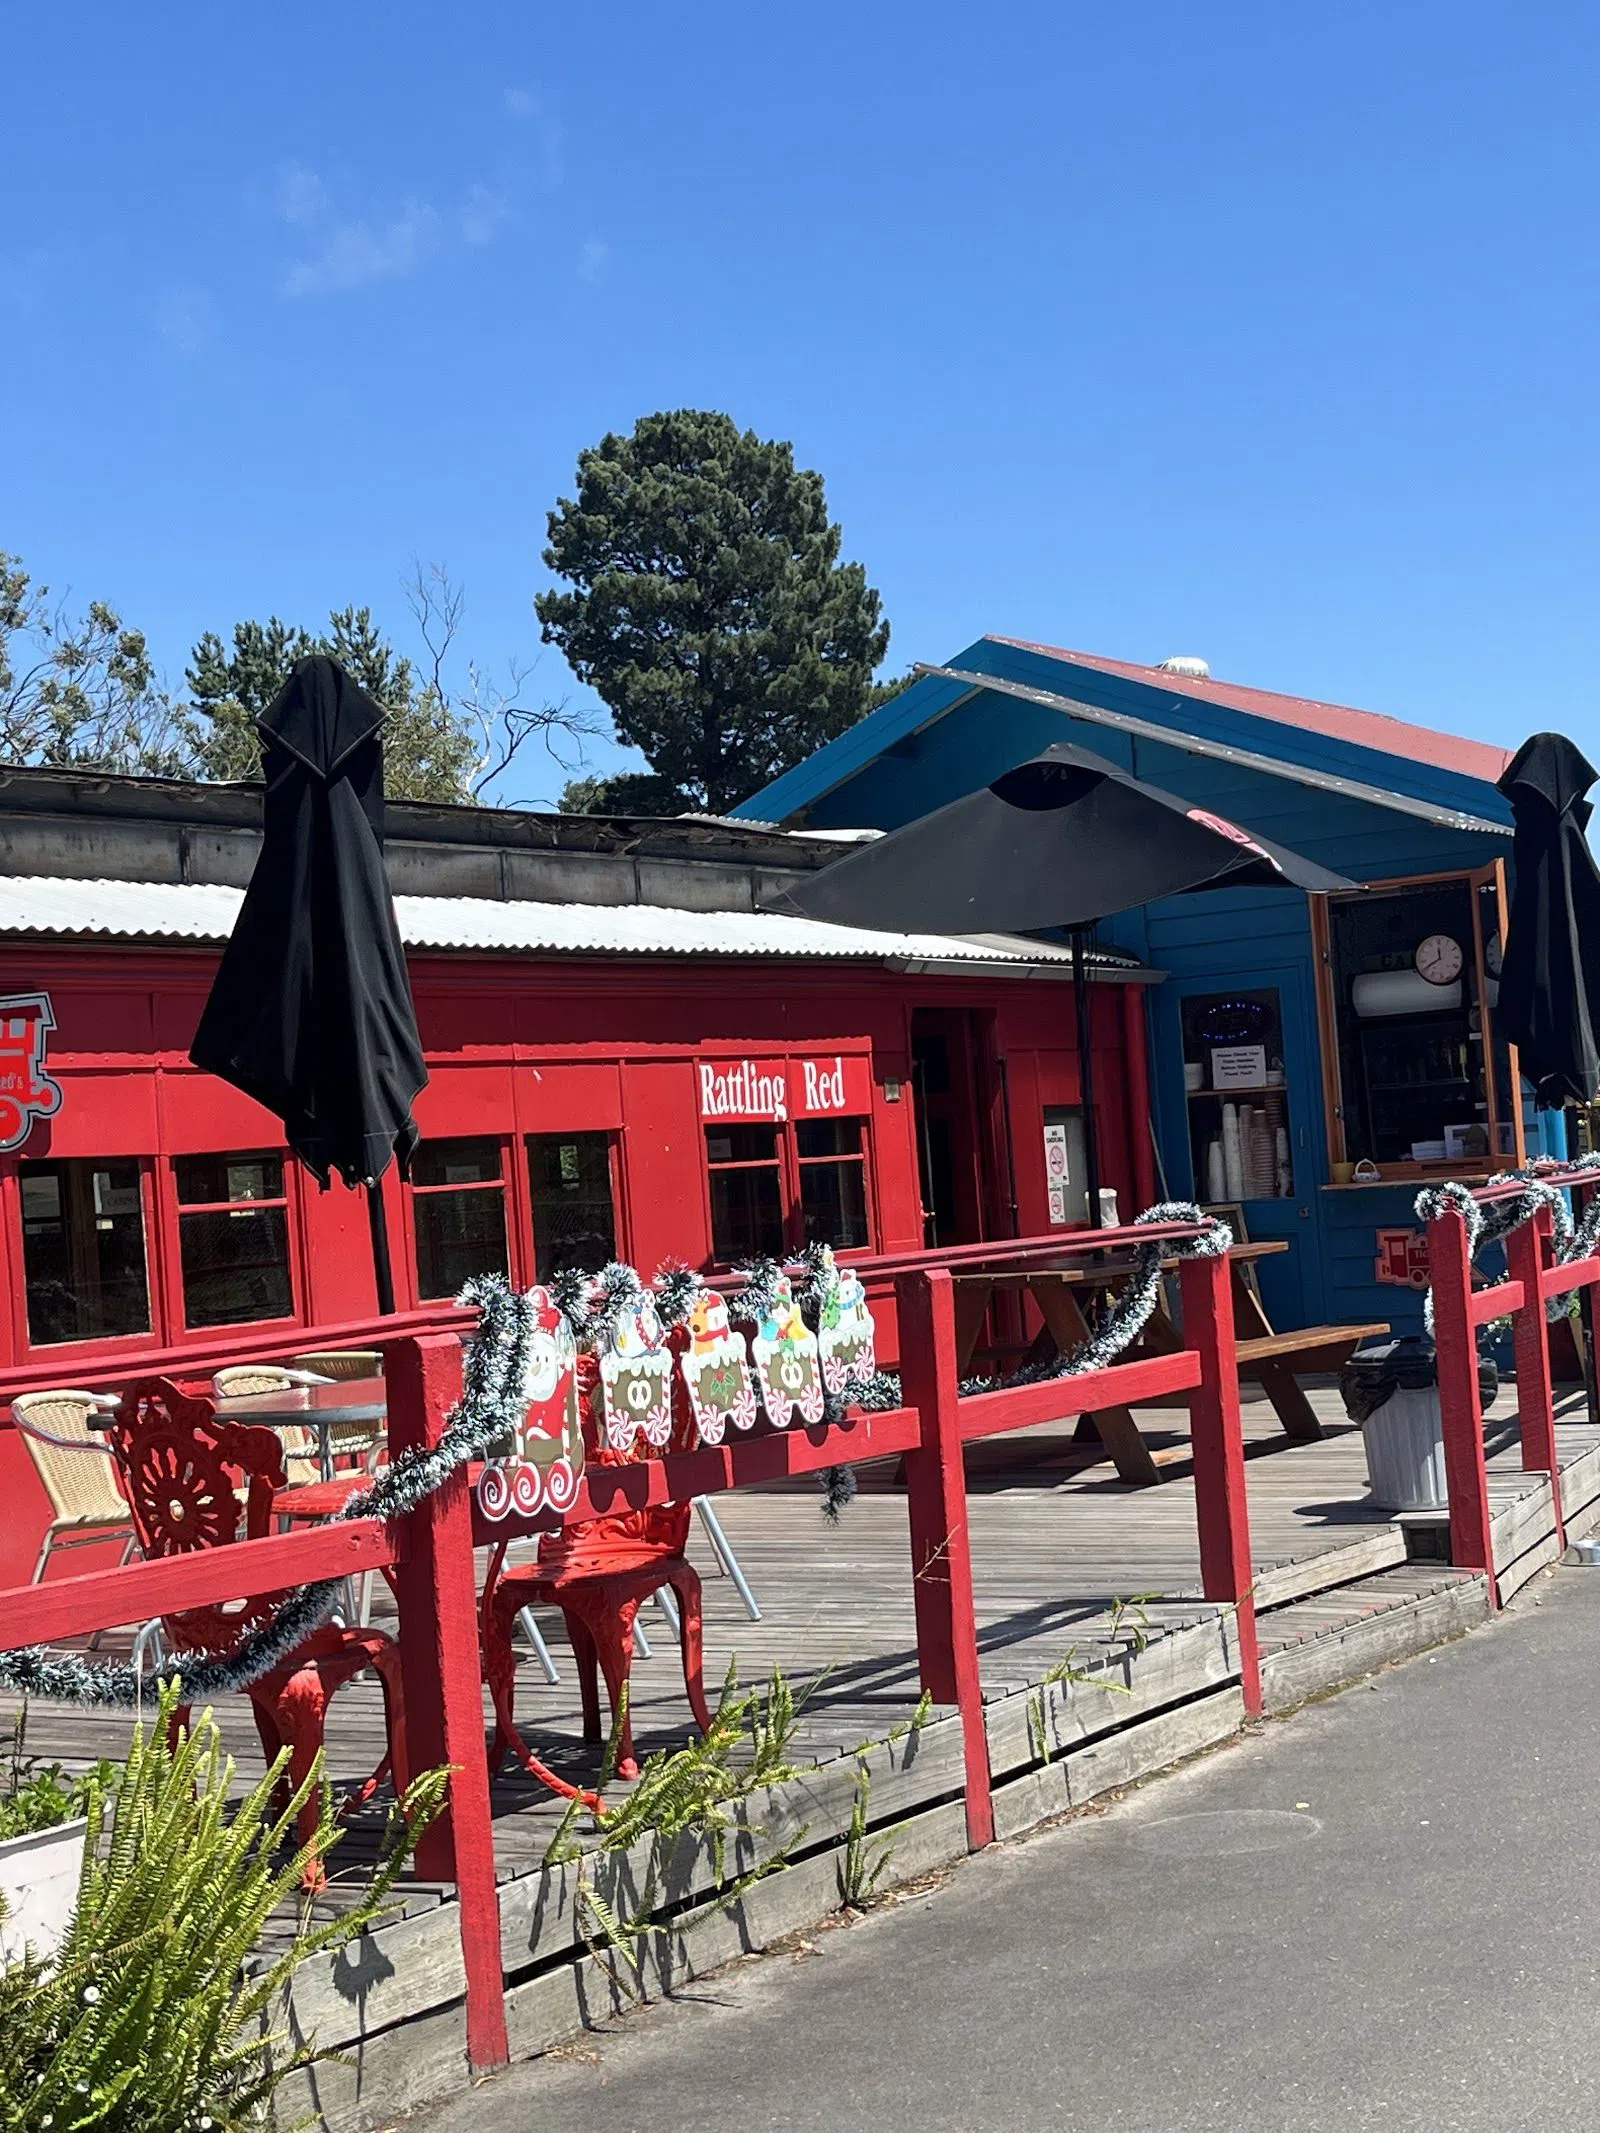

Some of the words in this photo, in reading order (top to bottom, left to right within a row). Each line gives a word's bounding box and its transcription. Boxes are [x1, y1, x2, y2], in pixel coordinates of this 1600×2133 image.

[0, 1072, 24, 1090] ed's
[699, 1060, 788, 1122] Rattling
[803, 1057, 846, 1110] Red
